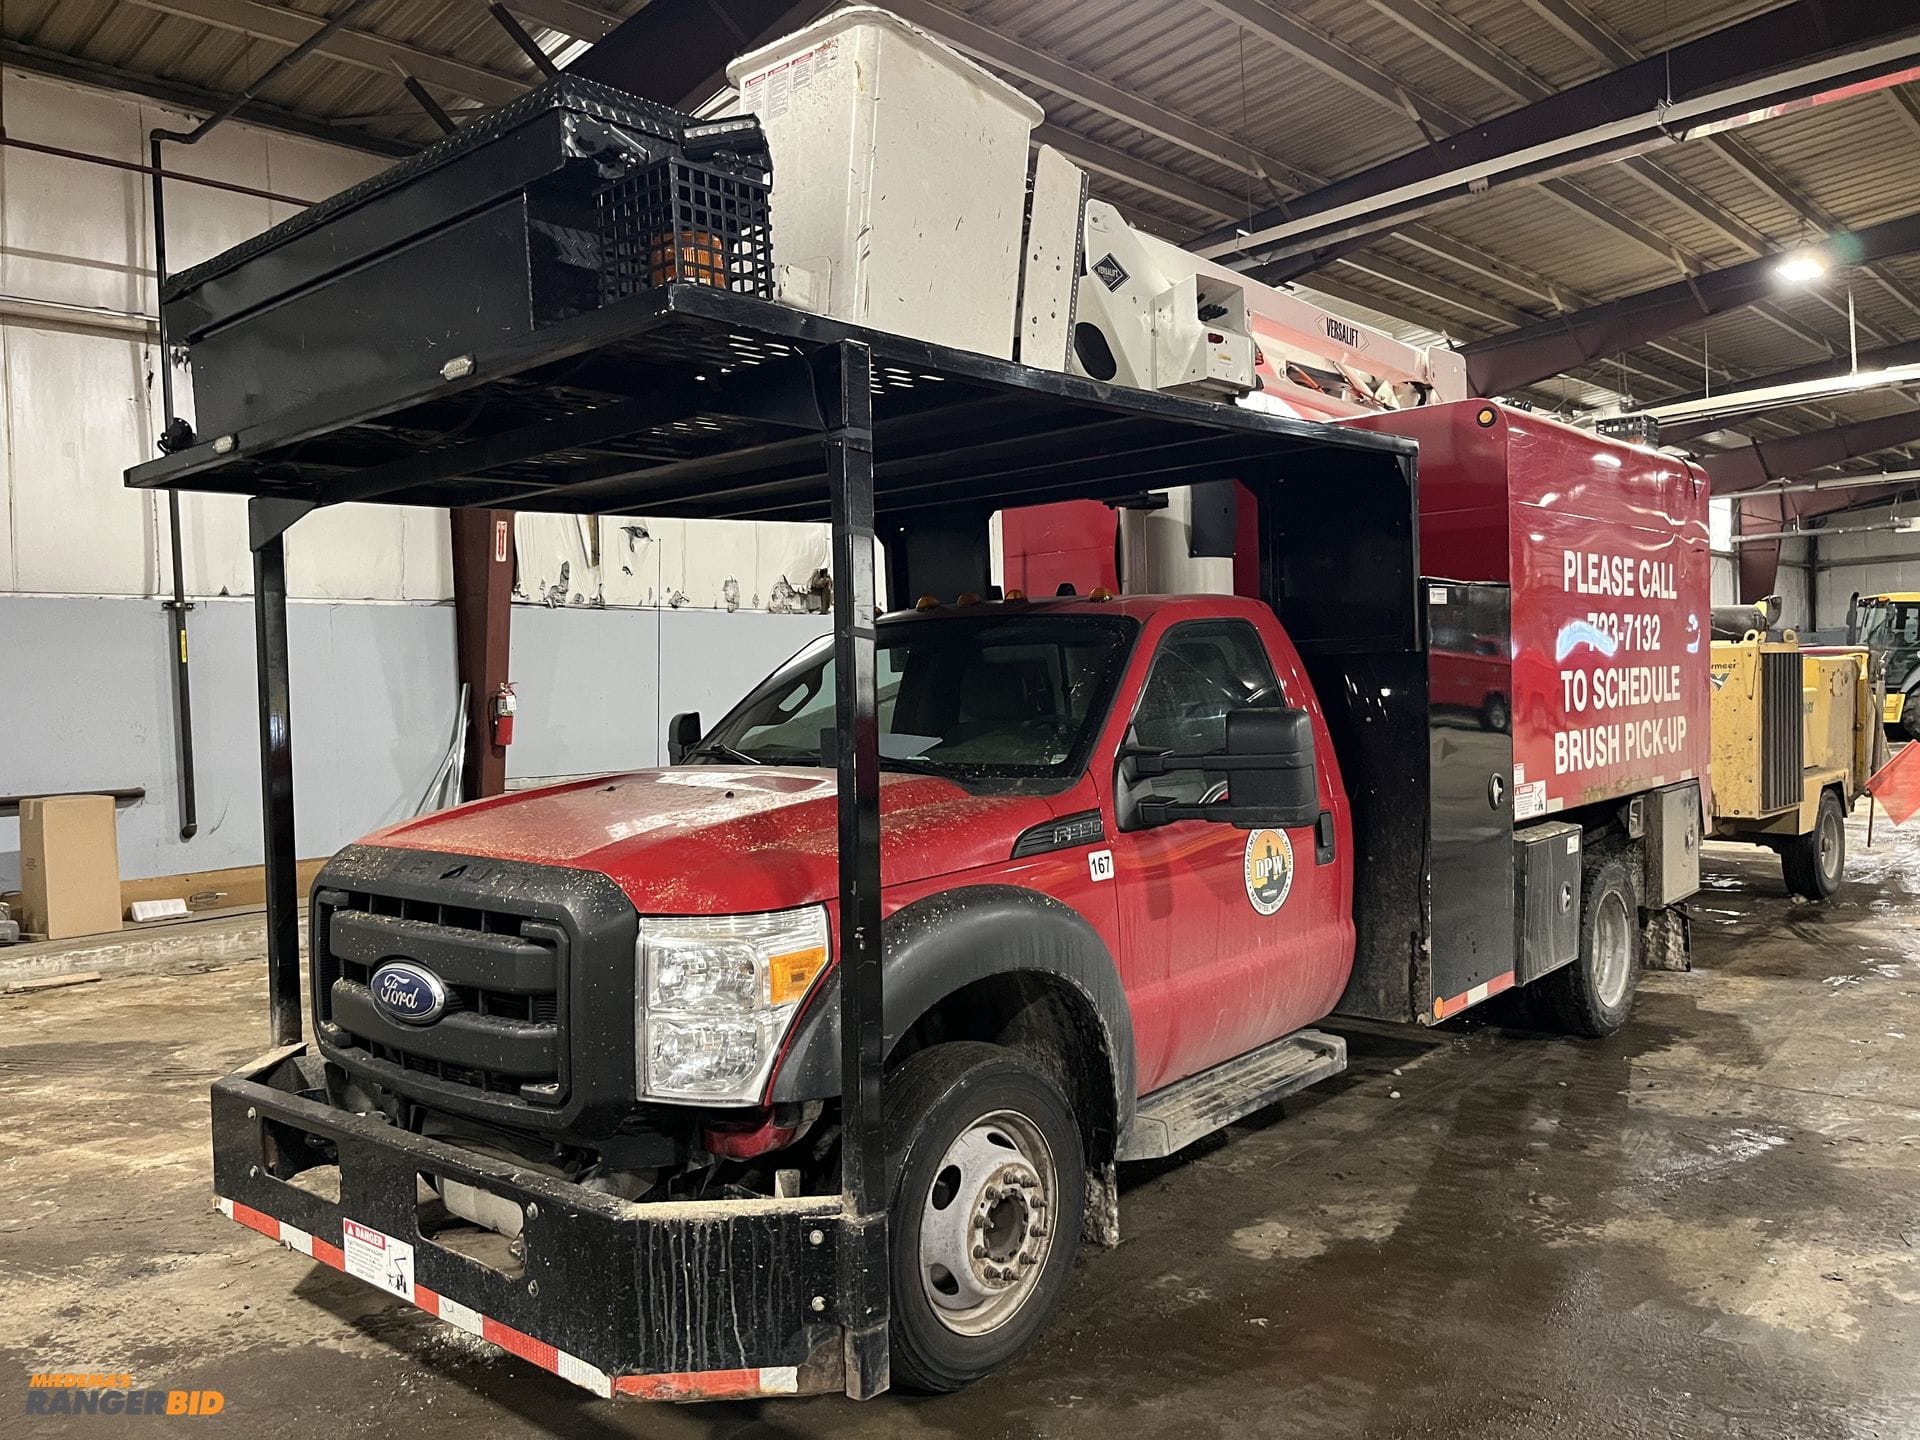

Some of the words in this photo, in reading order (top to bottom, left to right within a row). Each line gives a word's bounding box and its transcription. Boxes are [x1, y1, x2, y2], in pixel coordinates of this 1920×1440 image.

[1326, 316, 1359, 349] VERSALIFT
[1563, 550, 1635, 597] PLEASE
[1638, 559, 1678, 600] CALL
[1711, 662, 1737, 670] rmeer
[1560, 669, 1588, 713] TO
[1592, 665, 1681, 710] SCHEDULE
[1554, 724, 1620, 775] BRUSH
[1625, 715, 1687, 762] PICK-UP
[1092, 855, 1111, 876] 167
[1246, 829, 1259, 883] DEPARTMEN
[1255, 853, 1283, 879] DPW
[380, 973, 419, 1009] Ford
[355, 1226, 382, 1248] DANGER
